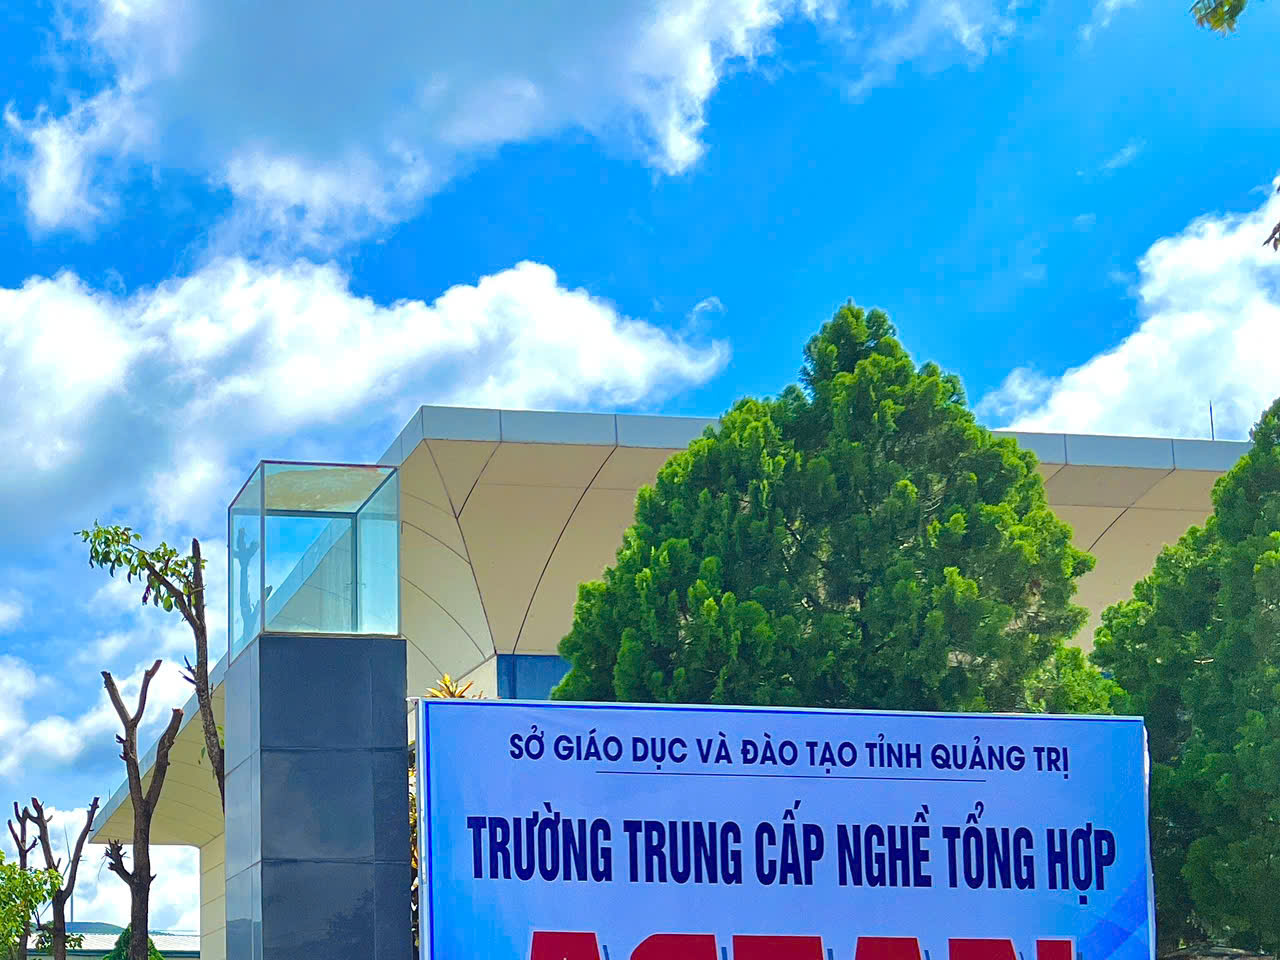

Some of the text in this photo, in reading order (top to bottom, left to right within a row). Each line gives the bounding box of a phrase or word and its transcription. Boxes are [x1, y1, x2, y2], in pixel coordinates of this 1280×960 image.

[510, 724, 1070, 780] SỞ GIÁO DỤC VÀ ĐÀO TẠO TỈNH QUẢNG TRỊ
[467, 800, 1116, 905] TRƯỜNG TRUNG CẤP NGHỀ TỔNG HỢP
